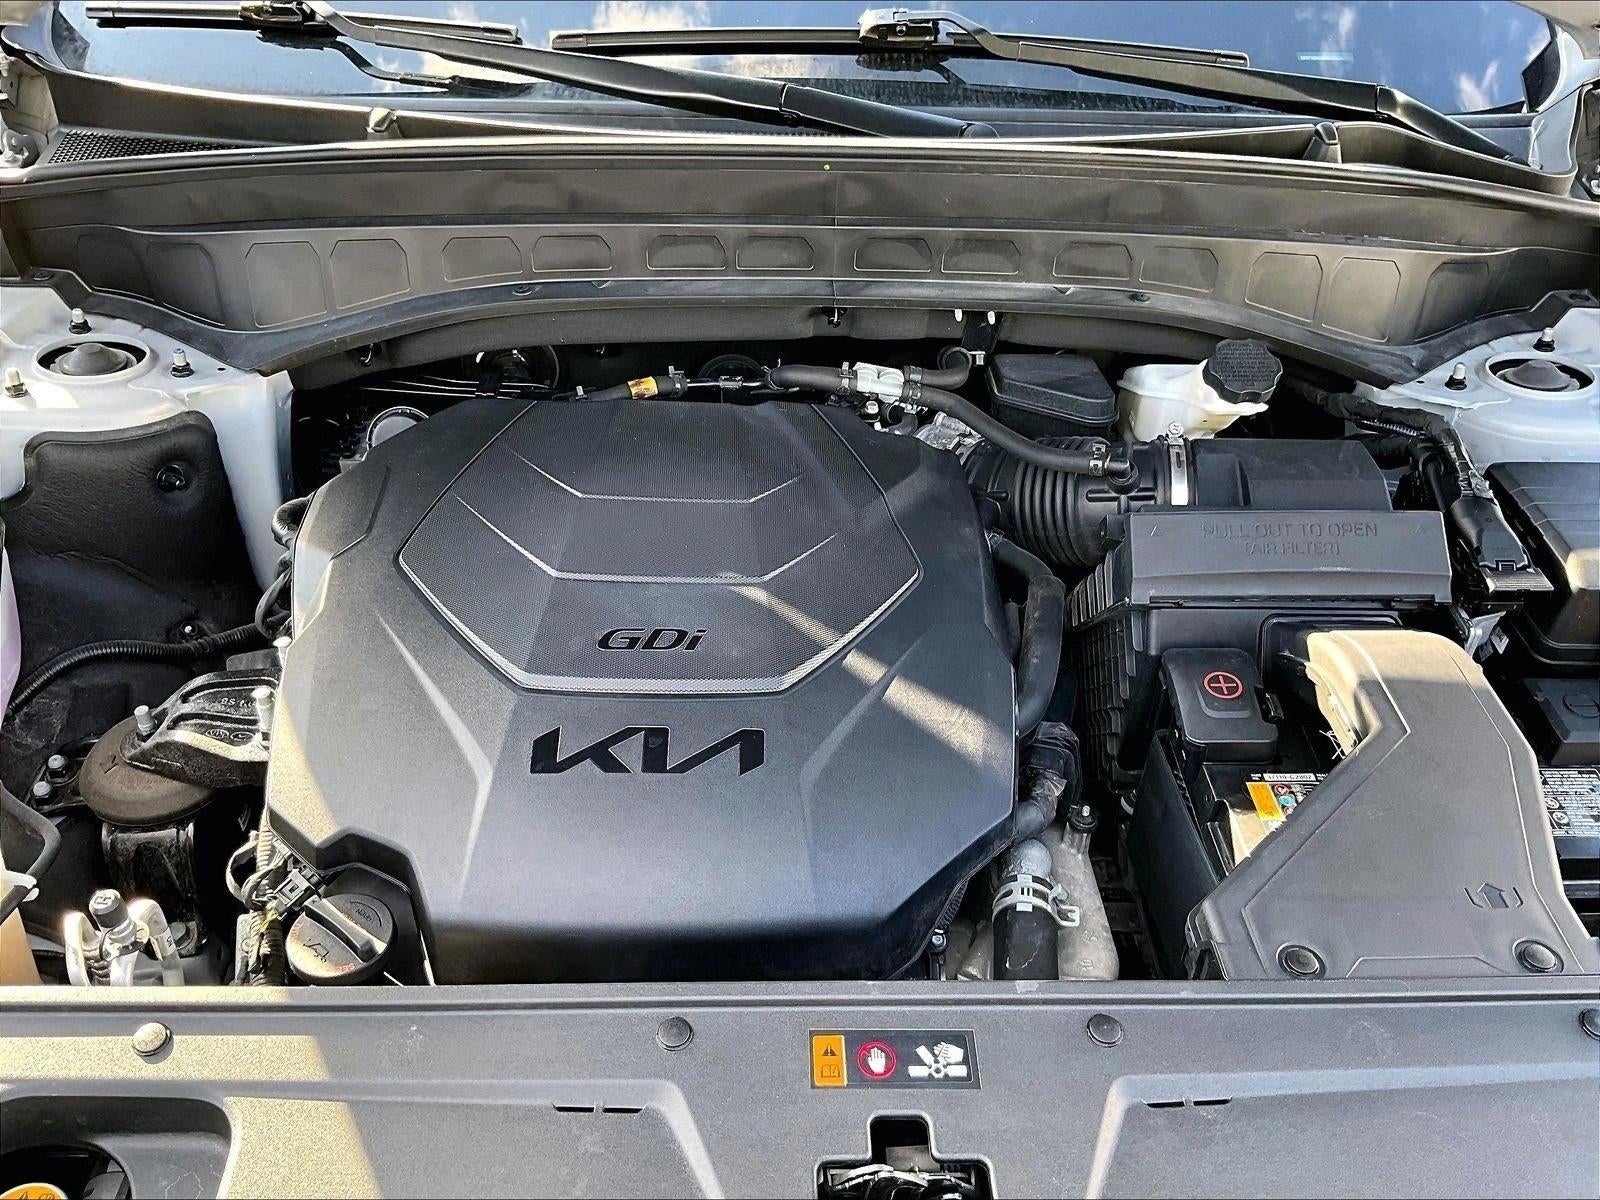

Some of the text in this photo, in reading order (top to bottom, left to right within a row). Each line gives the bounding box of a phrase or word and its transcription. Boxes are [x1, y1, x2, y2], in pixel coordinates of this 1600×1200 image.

[1202, 522, 1378, 539] PULL OUT TO OPEN
[596, 627, 708, 651] GDi
[530, 725, 766, 776] KIA
